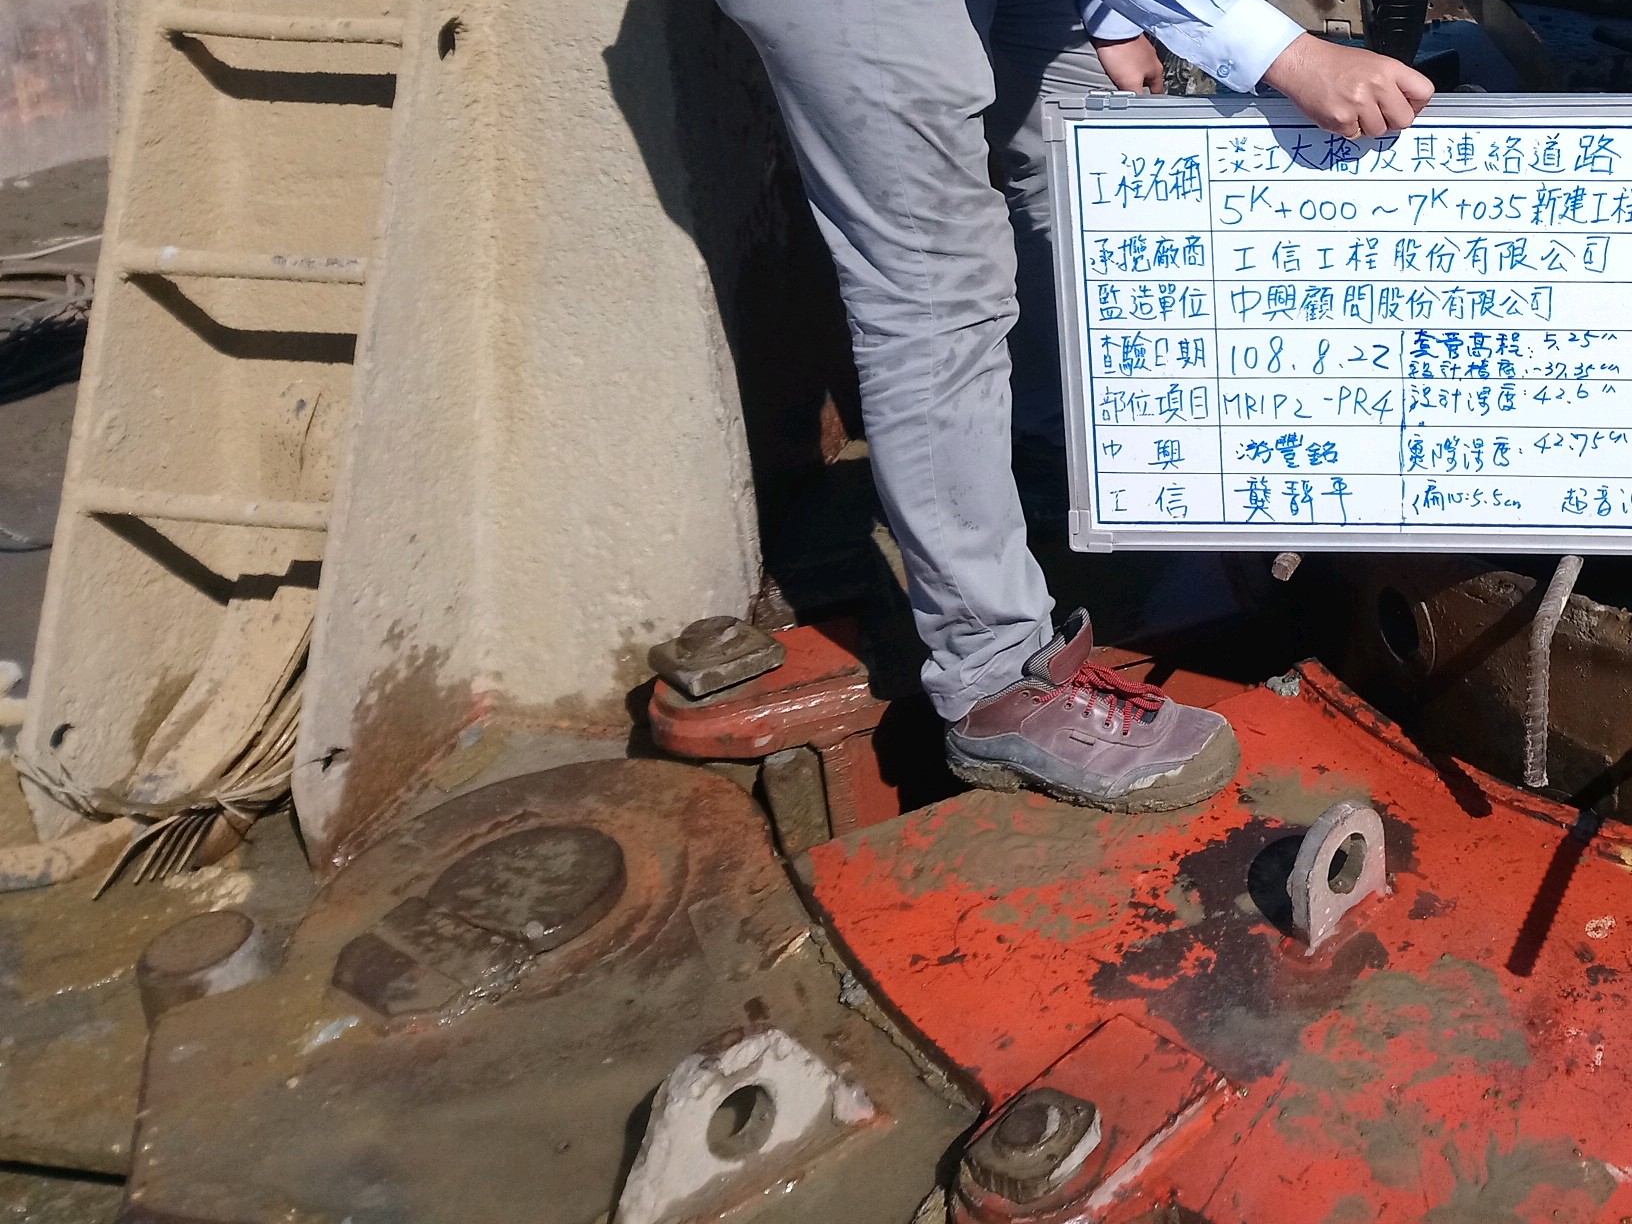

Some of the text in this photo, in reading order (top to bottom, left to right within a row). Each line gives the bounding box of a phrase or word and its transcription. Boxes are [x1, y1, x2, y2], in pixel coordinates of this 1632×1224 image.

[1215, 131, 1622, 175] 淡江大橋及其連絡道路
[1089, 153, 1203, 208] 工程名稱
[1089, 234, 1205, 275] 承攬廠商
[1232, 236, 1611, 275] 工信工程股份有限公司
[1098, 283, 1211, 322] 監造單位
[1230, 284, 1553, 324] 中興顧問股份有限公司
[1100, 331, 1206, 376] 查驗日期
[1100, 383, 1209, 423] 部位項目
